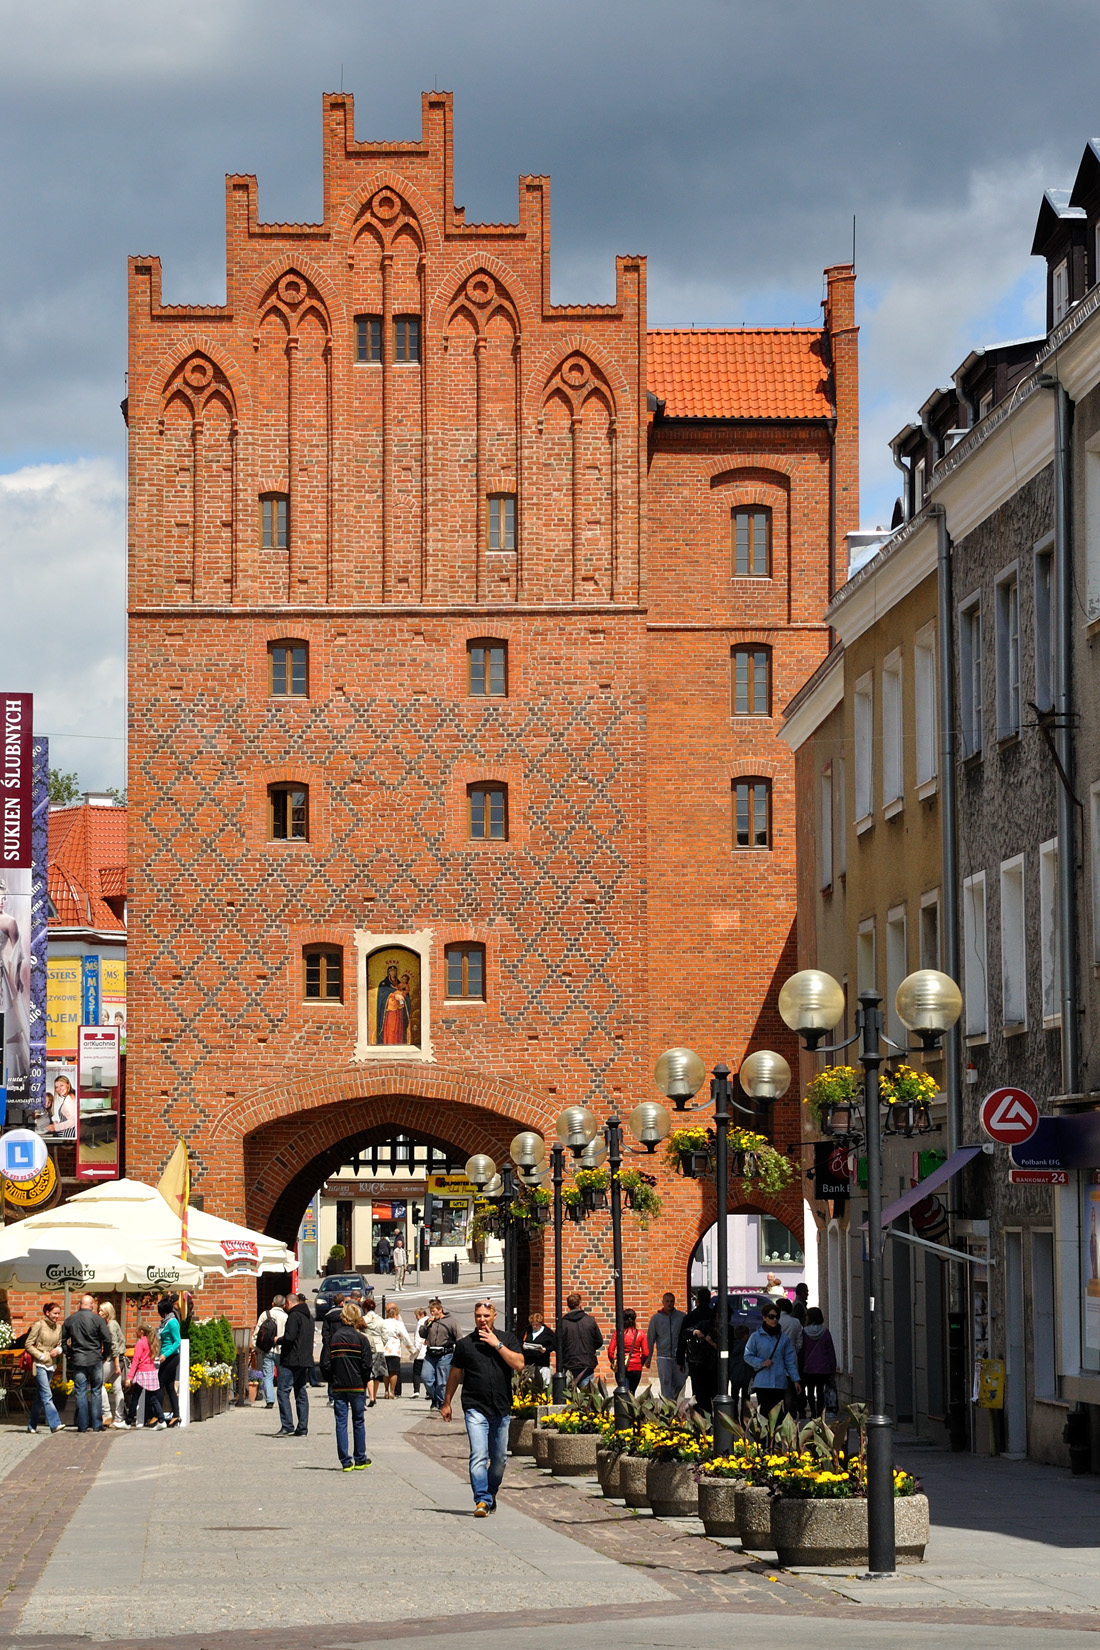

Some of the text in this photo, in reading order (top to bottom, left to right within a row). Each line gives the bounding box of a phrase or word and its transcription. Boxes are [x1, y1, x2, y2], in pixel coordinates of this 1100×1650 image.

[0, 700, 22, 861] SUKIEN ŚLUBNYCH
[106, 971, 118, 979] MS
[37, 1056, 42, 1064] 3
[31, 1083, 41, 1092] 67
[15, 1147, 28, 1162] L
[1051, 1173, 1065, 1183] 24
[822, 1184, 846, 1192] Bank
[45, 1263, 96, 1283] Carlsberg
[146, 1265, 180, 1283] Carlsberg
